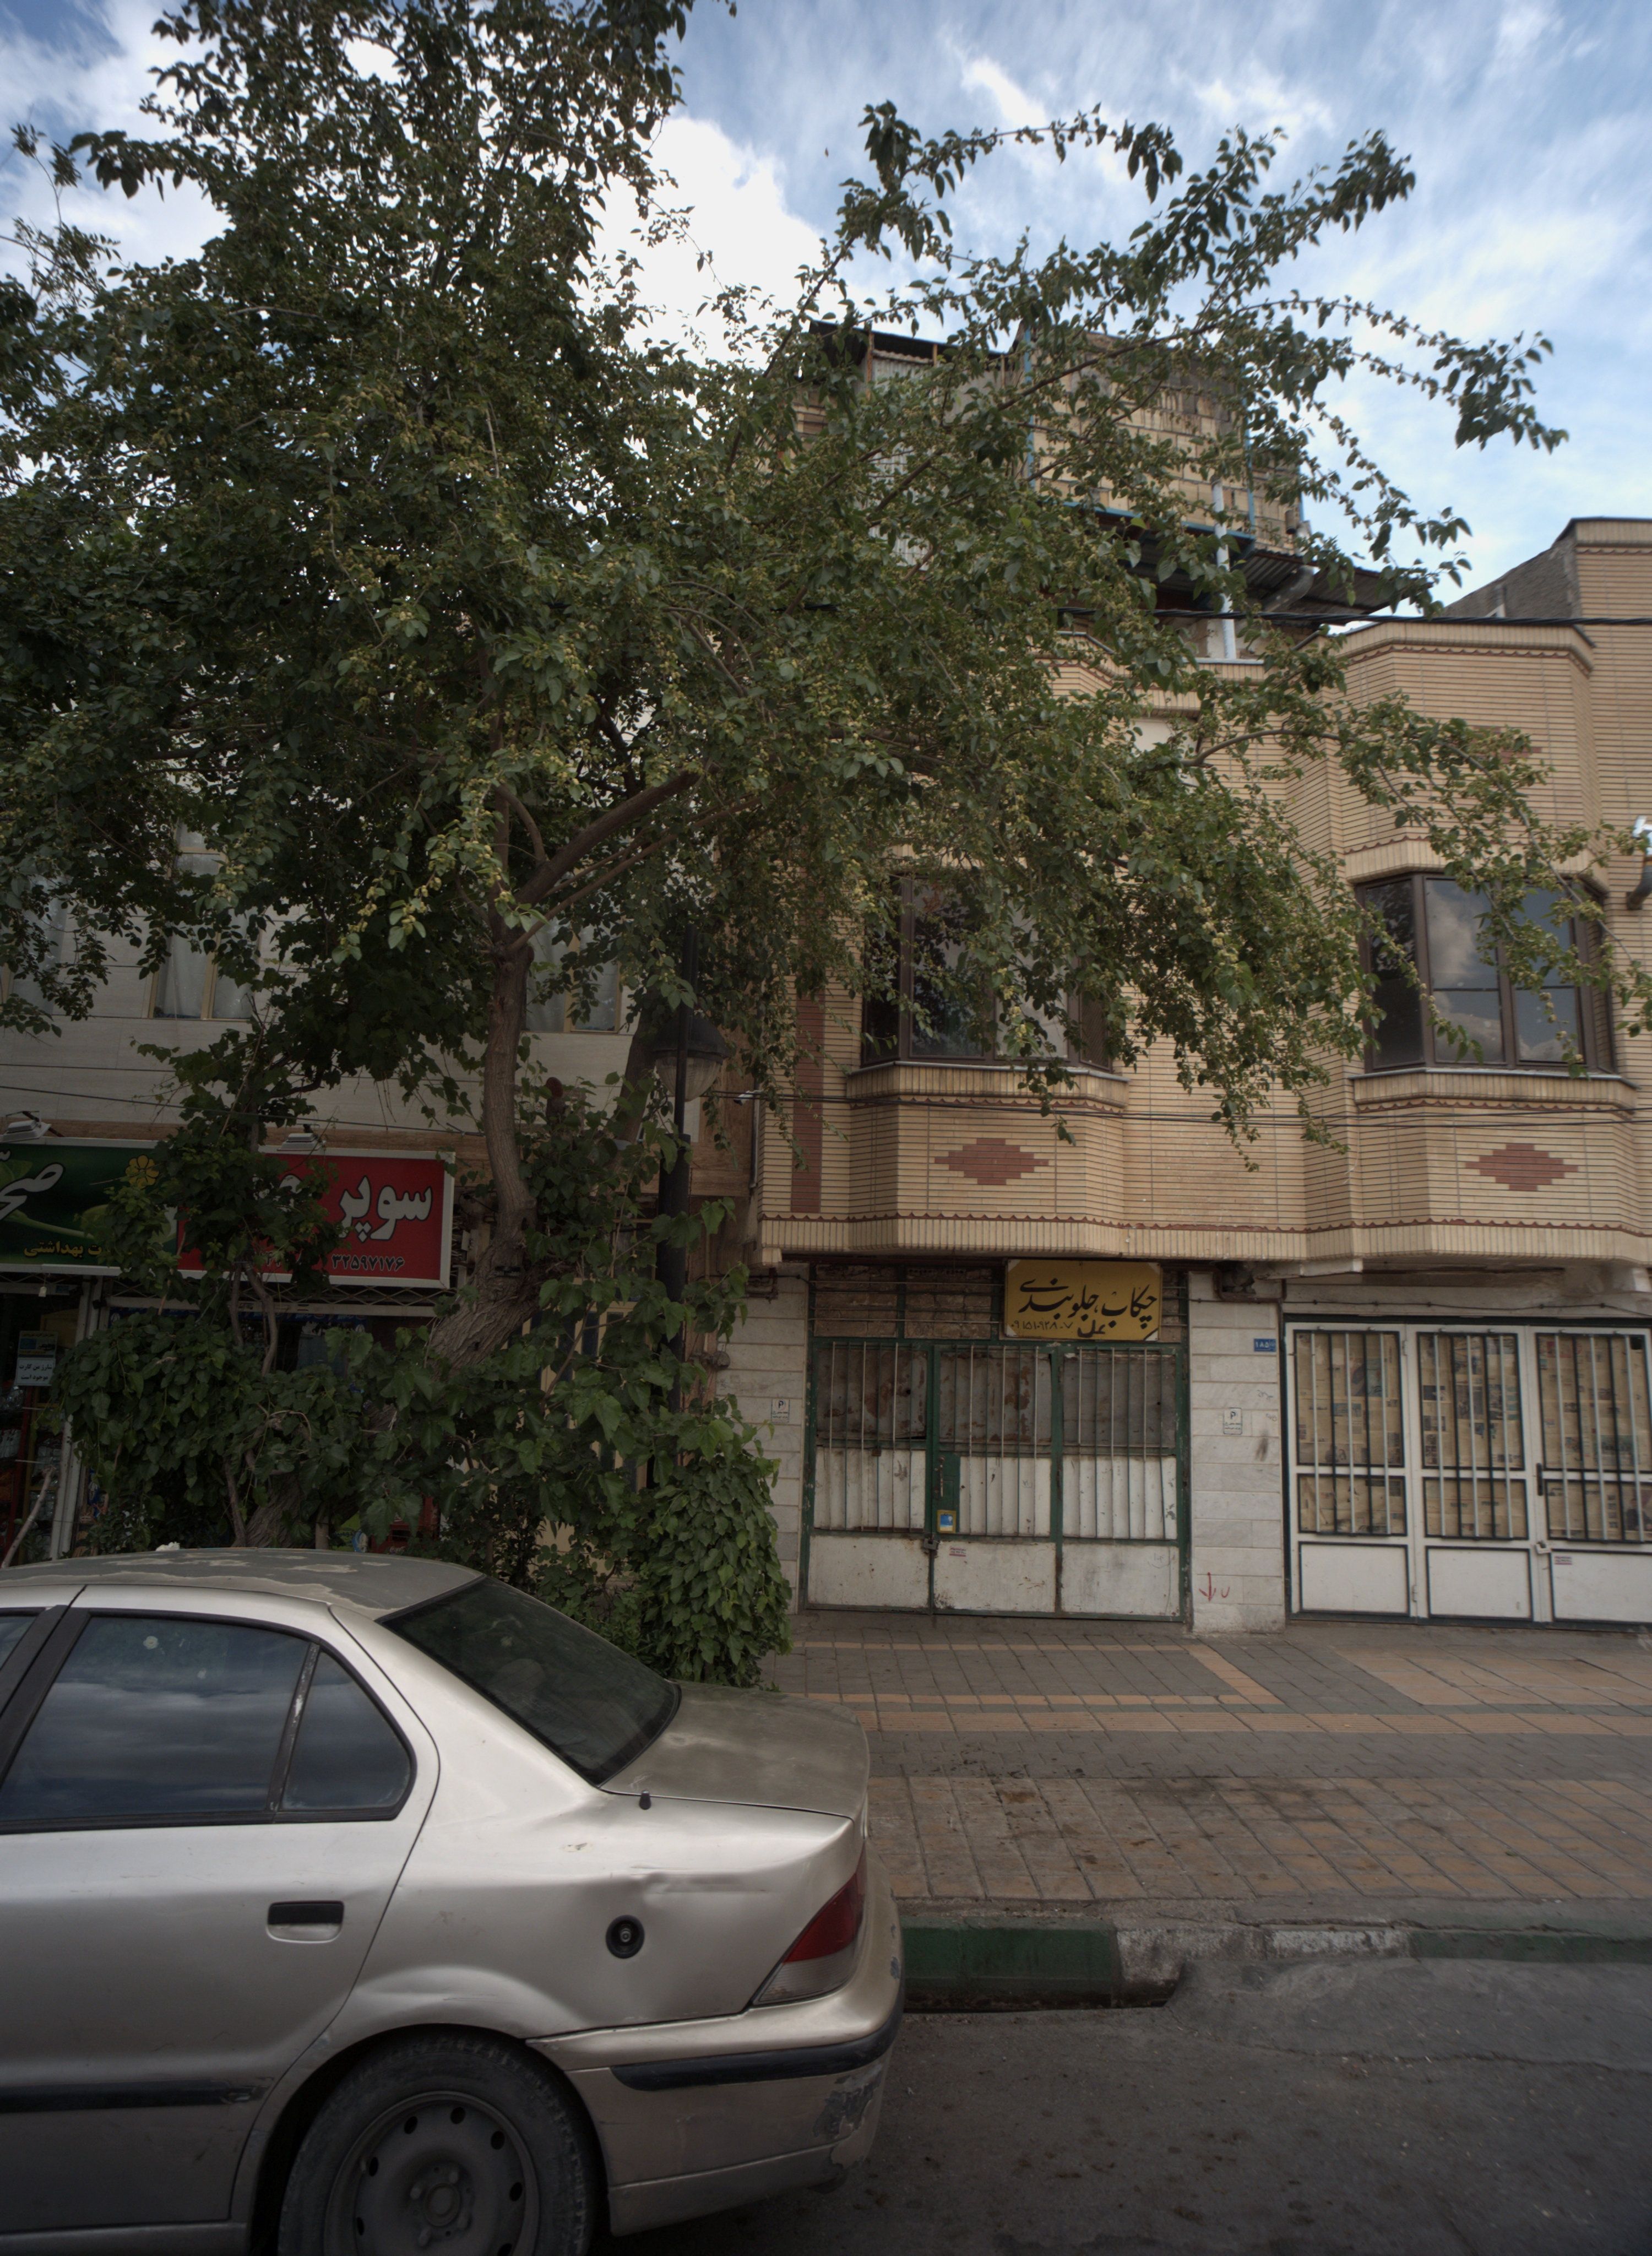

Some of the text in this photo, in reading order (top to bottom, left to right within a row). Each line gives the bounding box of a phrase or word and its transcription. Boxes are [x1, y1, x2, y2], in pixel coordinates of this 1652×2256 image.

[338, 1175, 433, 1244] سوپر
[23, 1240, 84, 1259] بهداشتی
[332, 1254, 405, 1272] ۳۲۵۹۷۱۷۶
[778, 1400, 784, 1408] P
[1230, 1411, 1236, 1419] P
